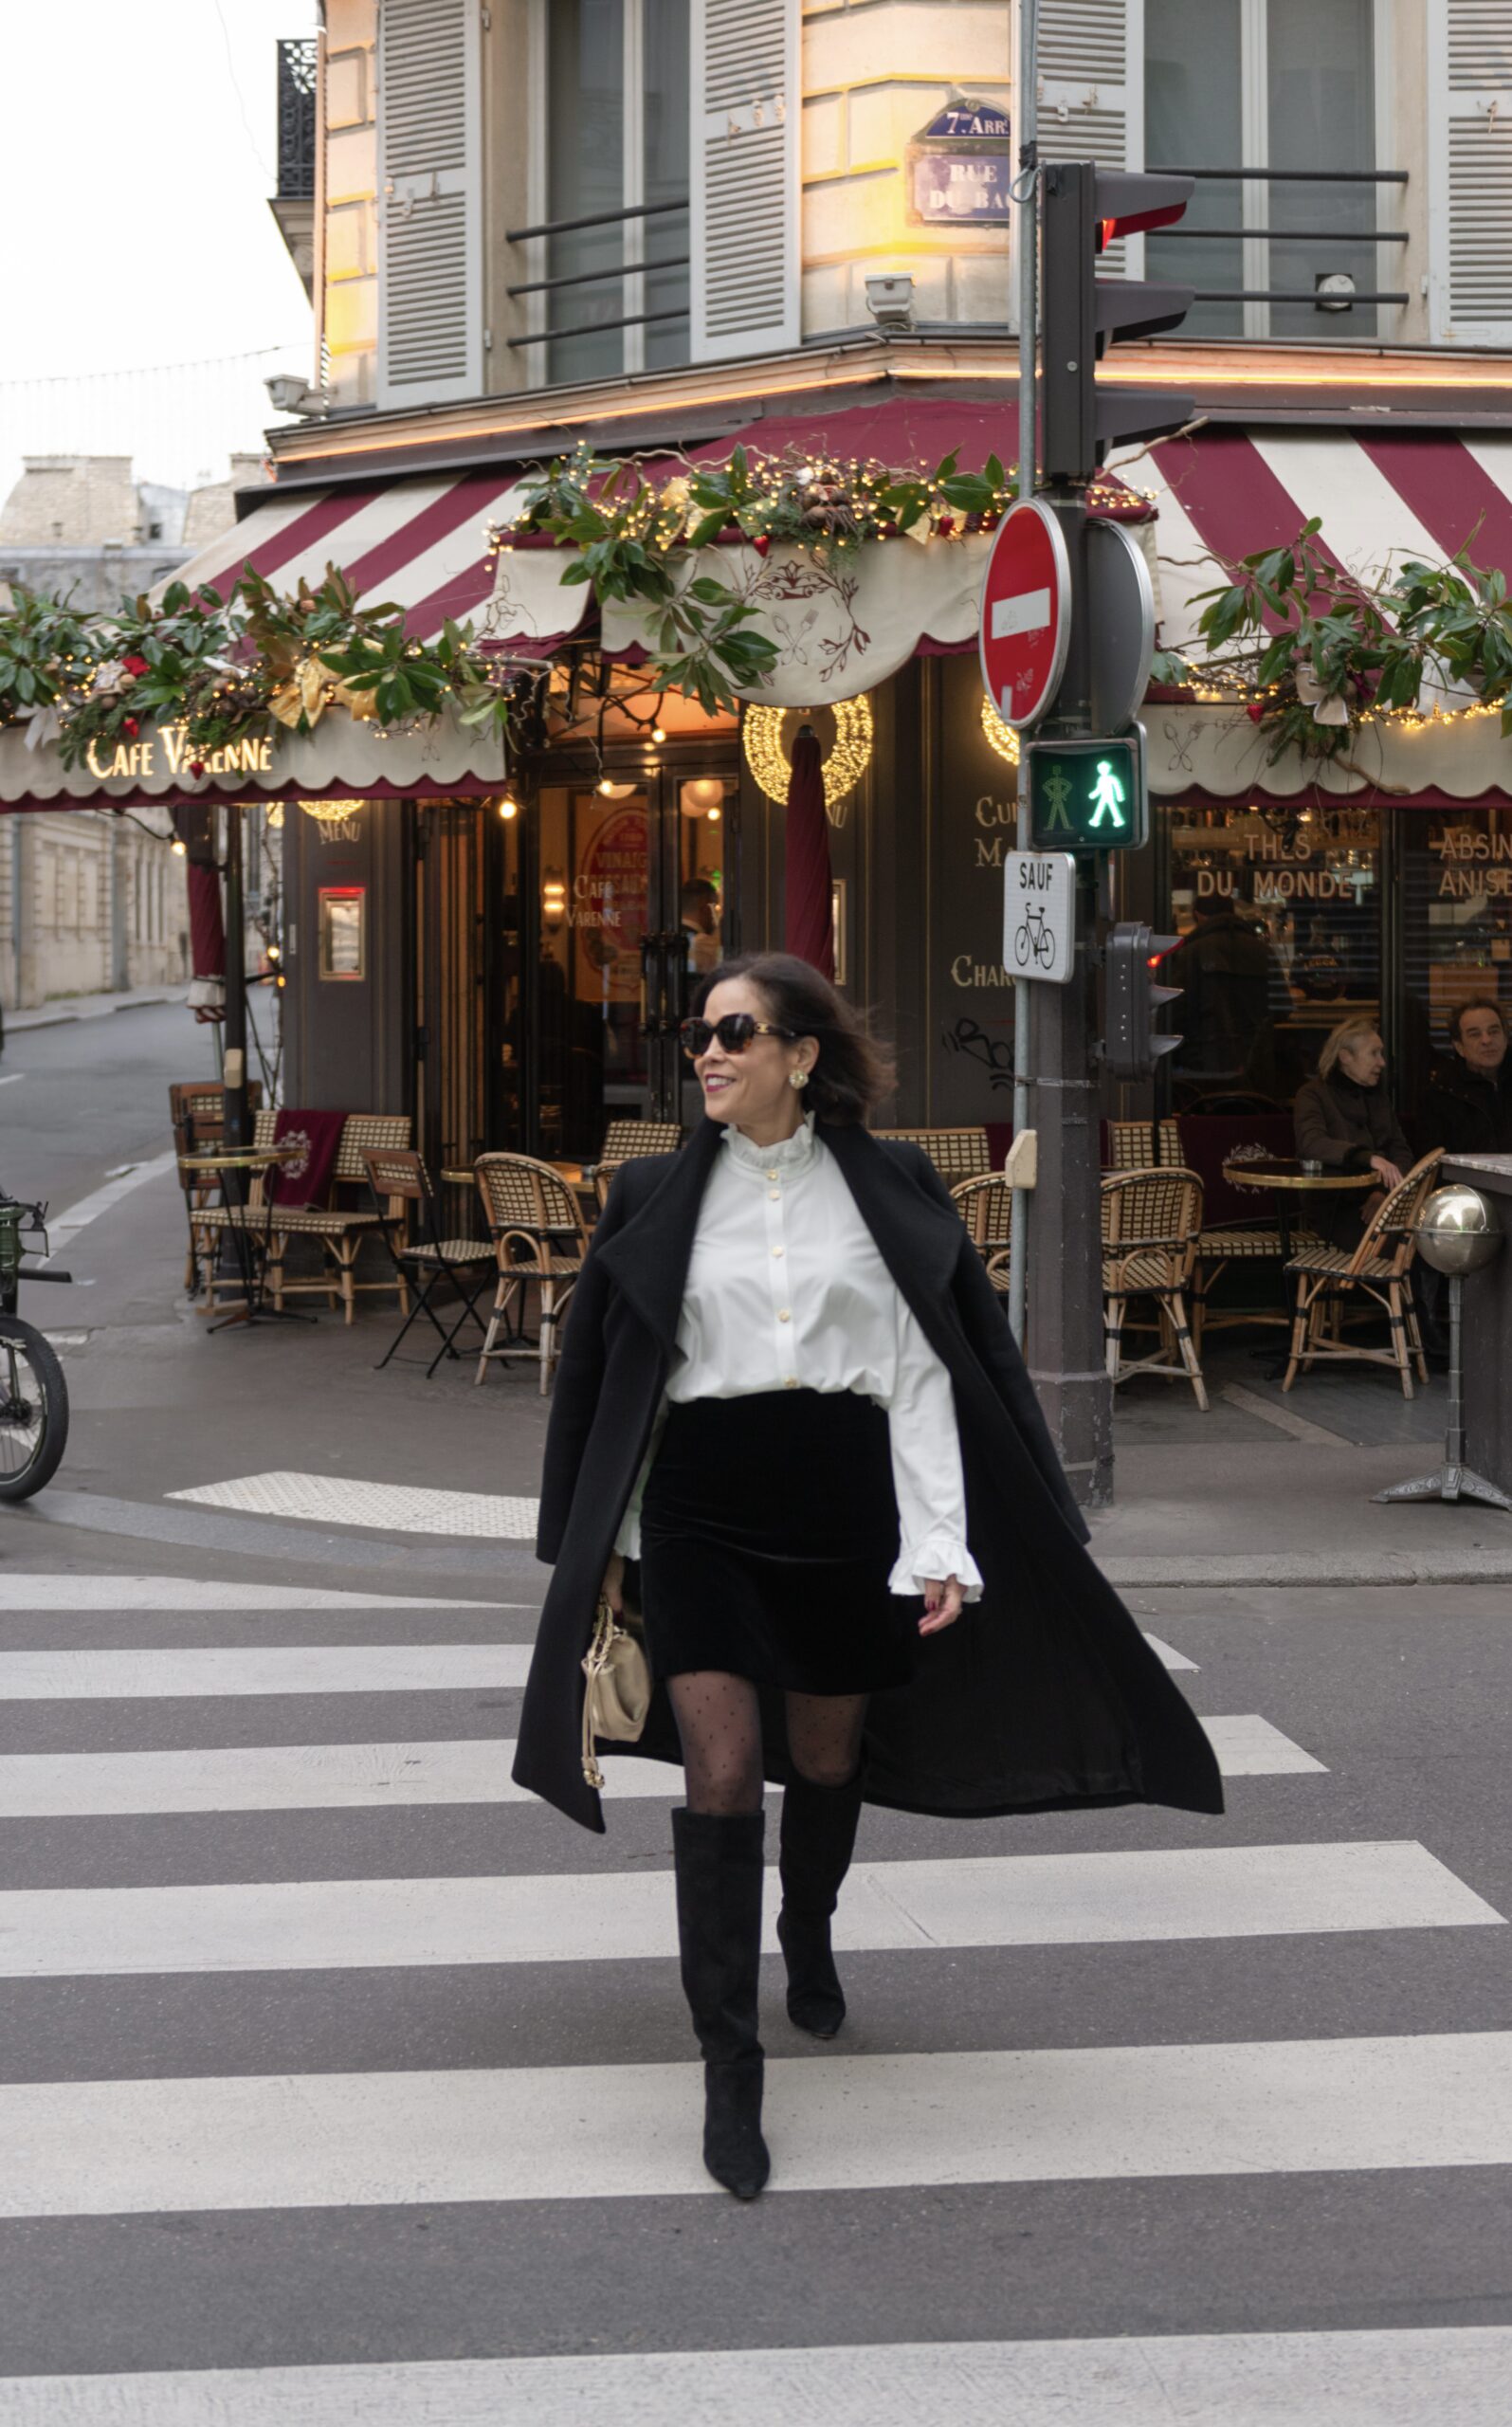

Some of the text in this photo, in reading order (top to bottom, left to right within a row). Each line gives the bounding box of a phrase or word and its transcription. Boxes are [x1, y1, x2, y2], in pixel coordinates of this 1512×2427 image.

[949, 163, 998, 182] RUE
[929, 190, 965, 209] DU
[316, 820, 362, 845] MENU
[1019, 862, 1053, 891] SAUF
[1197, 870, 1354, 899] DU MONDE
